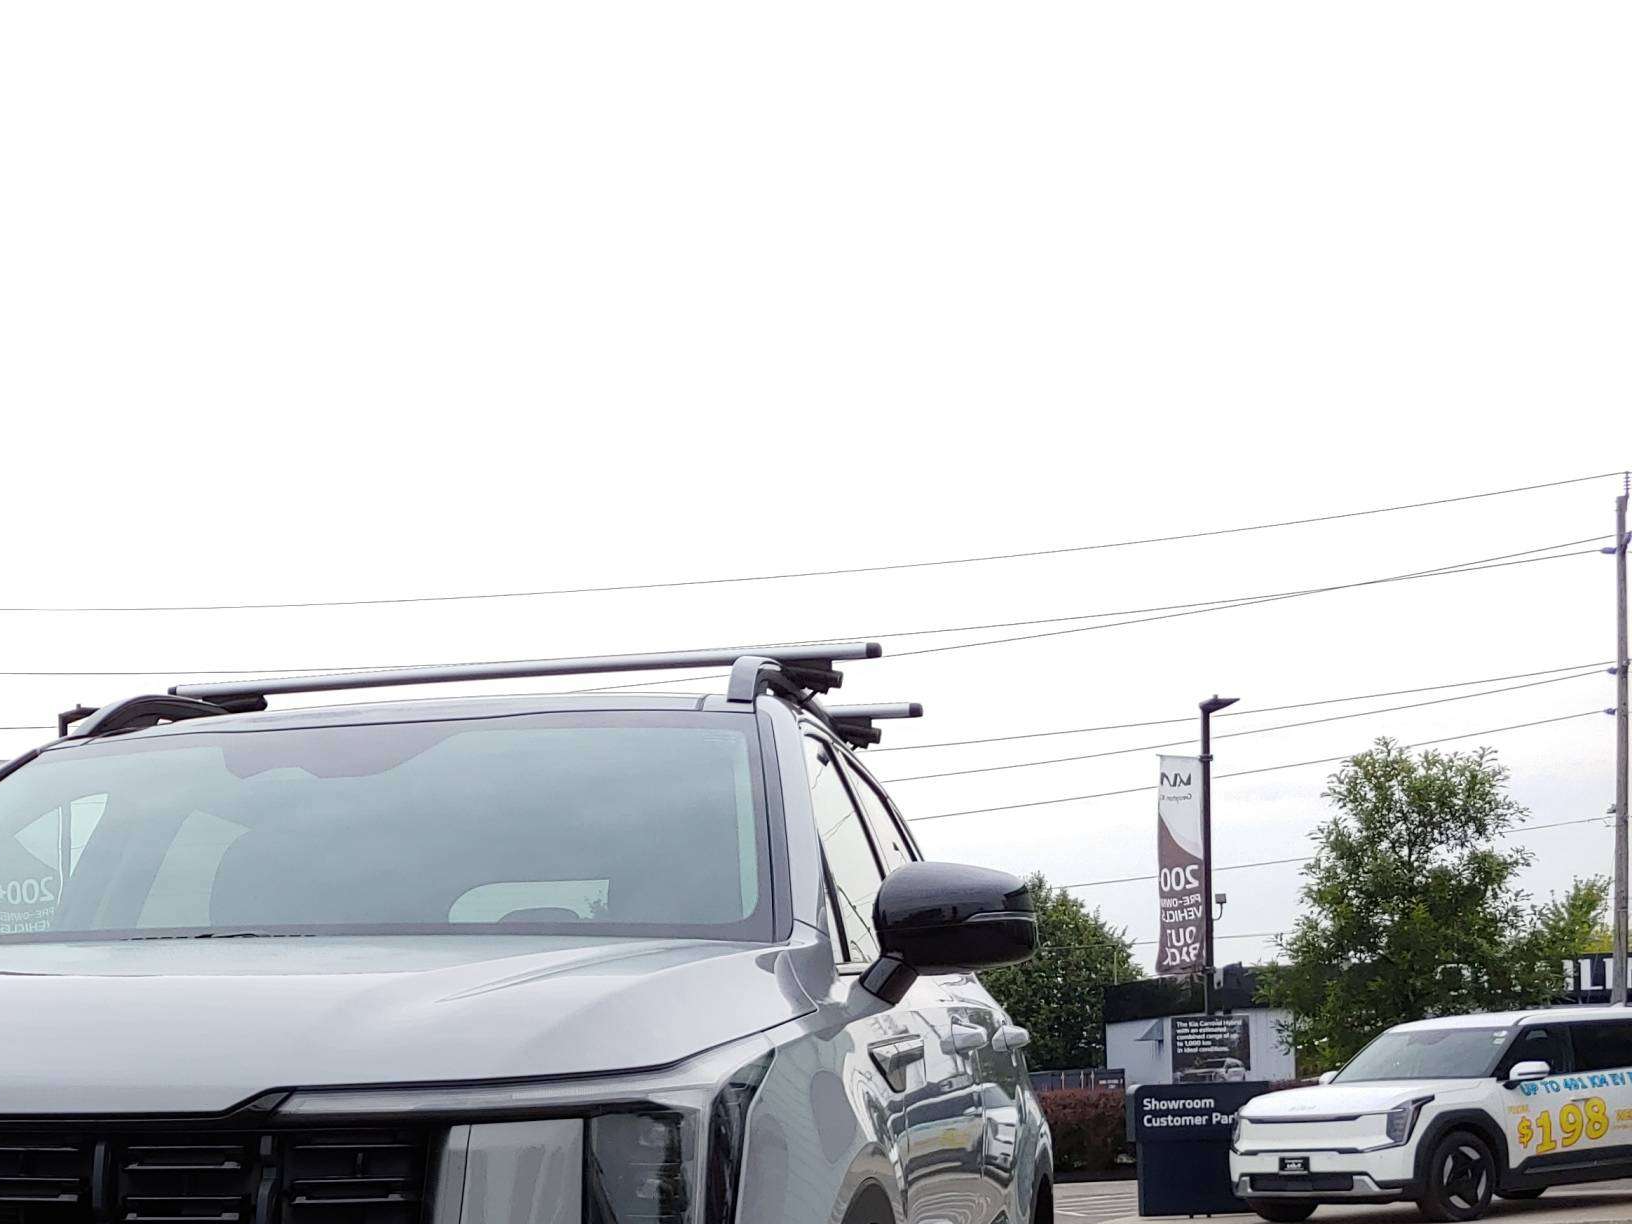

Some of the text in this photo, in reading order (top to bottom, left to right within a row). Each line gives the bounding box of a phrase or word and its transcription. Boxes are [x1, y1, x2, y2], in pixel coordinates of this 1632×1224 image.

[1143, 1097, 1215, 1111] Showroom
[1143, 1114, 1209, 1127] Customer
[1517, 1096, 1609, 1156] $198
